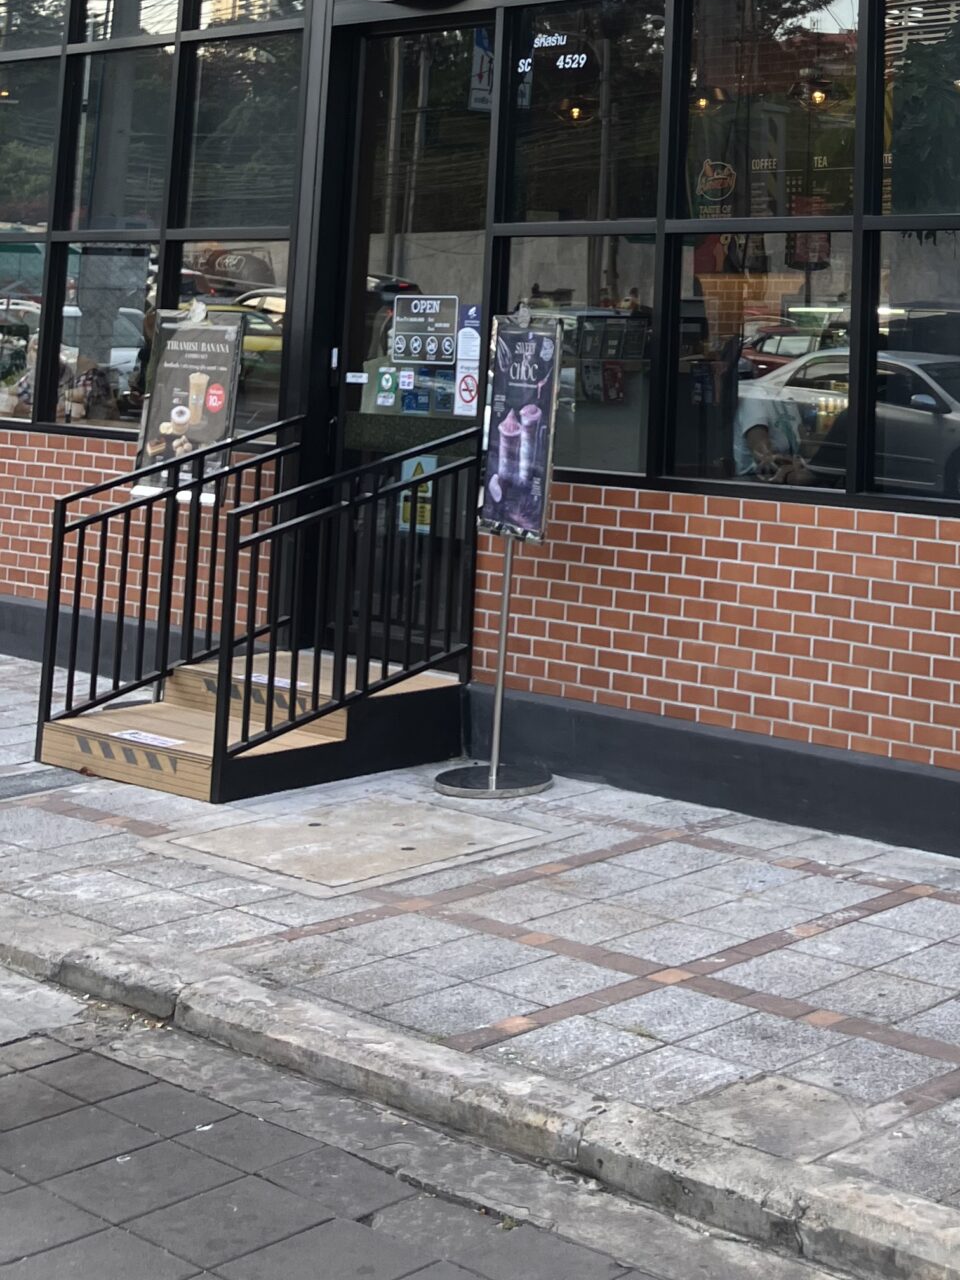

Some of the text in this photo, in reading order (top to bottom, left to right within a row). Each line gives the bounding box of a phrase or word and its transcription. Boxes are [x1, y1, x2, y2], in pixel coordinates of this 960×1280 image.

[556, 54, 587, 69] 4529
[752, 158, 777, 170] COFFEE
[813, 156, 828, 168] TEA
[411, 300, 440, 313] OPEN
[200, 342, 230, 353] BANANA
